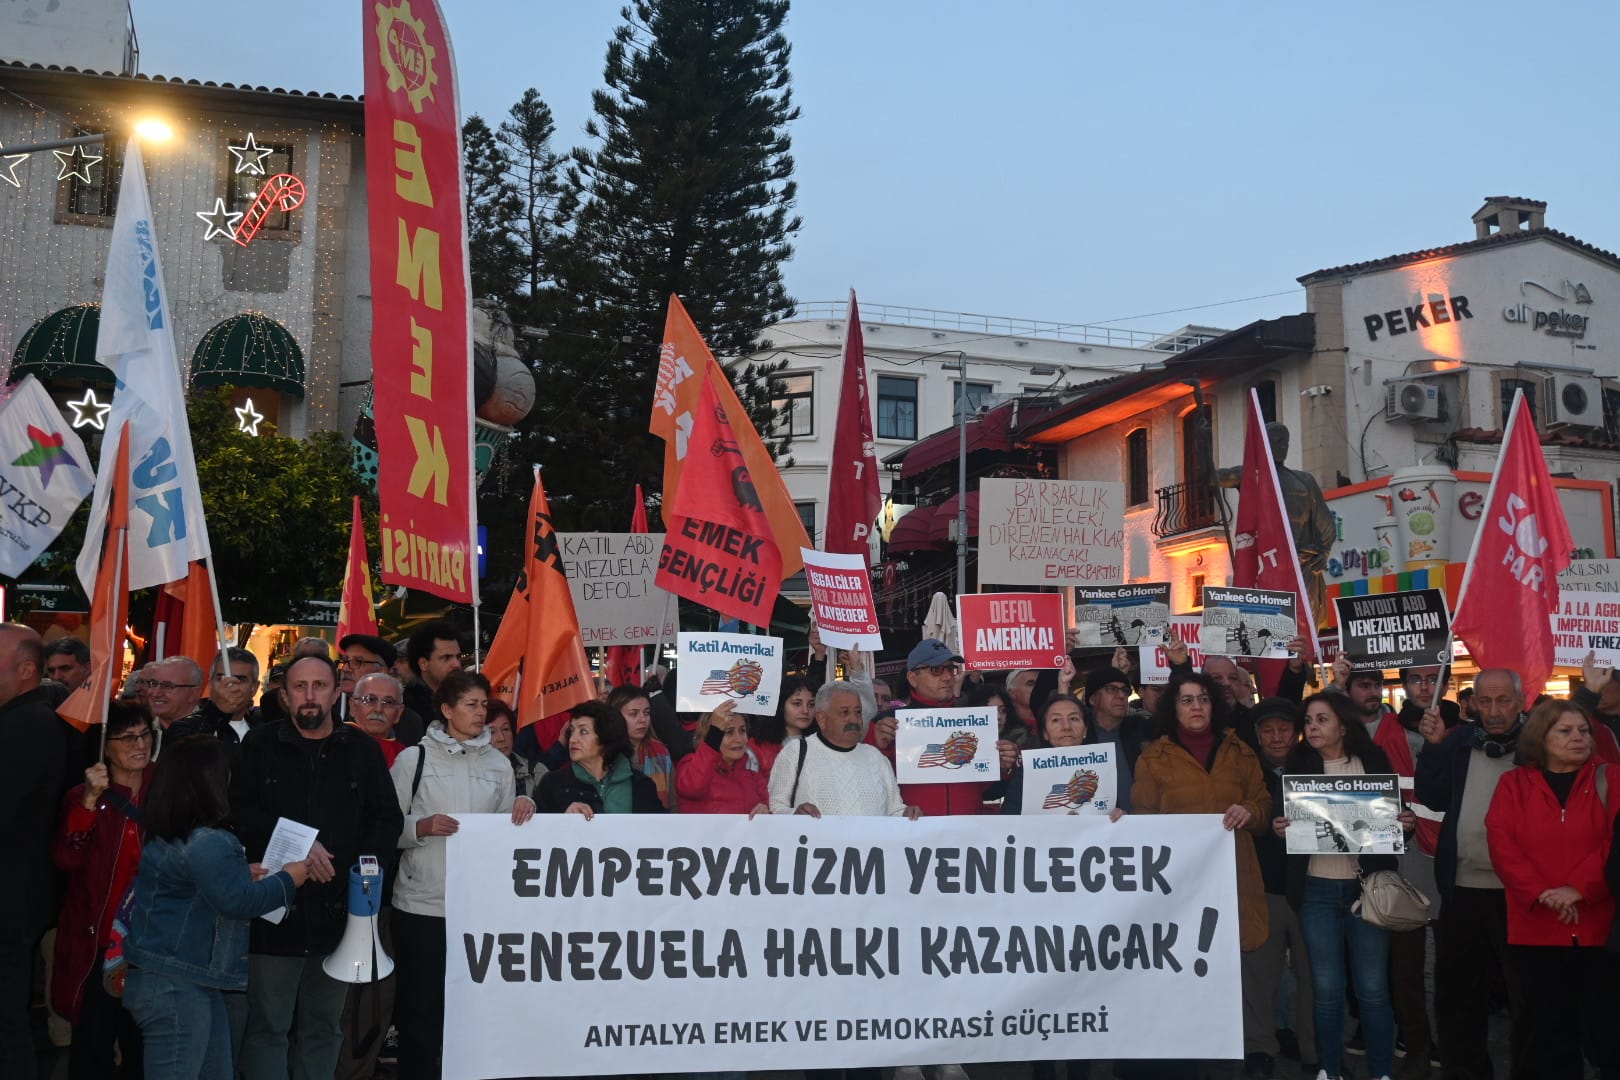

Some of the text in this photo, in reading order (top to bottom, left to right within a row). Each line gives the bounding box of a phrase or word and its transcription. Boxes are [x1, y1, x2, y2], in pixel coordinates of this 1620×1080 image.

[1364, 295, 1474, 341] PEKER
[1015, 481, 1110, 510] BARBARLIK
[563, 536, 654, 555] KATIL ABD
[682, 517, 764, 564] EMEK
[1063, 526, 1123, 549] HALKLAR
[1009, 545, 1088, 561] KAZANACAK!
[658, 544, 766, 606] GENÇLİĞİ
[1045, 564, 1085, 579] EMEK
[1502, 545, 1544, 592] PAR
[1557, 563, 1610, 576] IKILSIN
[830, 590, 868, 606] ZAMAN
[1080, 586, 1166, 599] Yankee Go Home!
[1208, 591, 1291, 606] Yankee Go Home!
[818, 603, 868, 622] KAYBEDER!
[990, 600, 1036, 623] DEFOL
[1353, 595, 1427, 617] HAYDUT ABD
[1564, 601, 1572, 615] A
[1576, 602, 1590, 616] LA
[582, 627, 618, 641] EMEK
[1171, 623, 1200, 643] ANK
[1349, 612, 1440, 637] VENEZUELA'DAN
[1557, 618, 1620, 633] IMPERIALIS
[976, 624, 1054, 651] AMERİKA!
[1367, 634, 1395, 655] ELİNİ
[1553, 634, 1620, 649] NTRA VENEZ
[689, 641, 774, 657] Katil Amerika!
[936, 715, 989, 727] Amerika!
[1033, 752, 1108, 769] Katil Amerika!
[1290, 780, 1393, 792] Yankee Go Home!
[512, 834, 1172, 899] EMPERYALİZM YENİLECEK
[463, 928, 748, 983] VENEZUELA
[763, 926, 900, 979] HALKI
[584, 1005, 1109, 1047] ANTALYA EMEK VE DEMOKRASİ GÜÇLERİ
